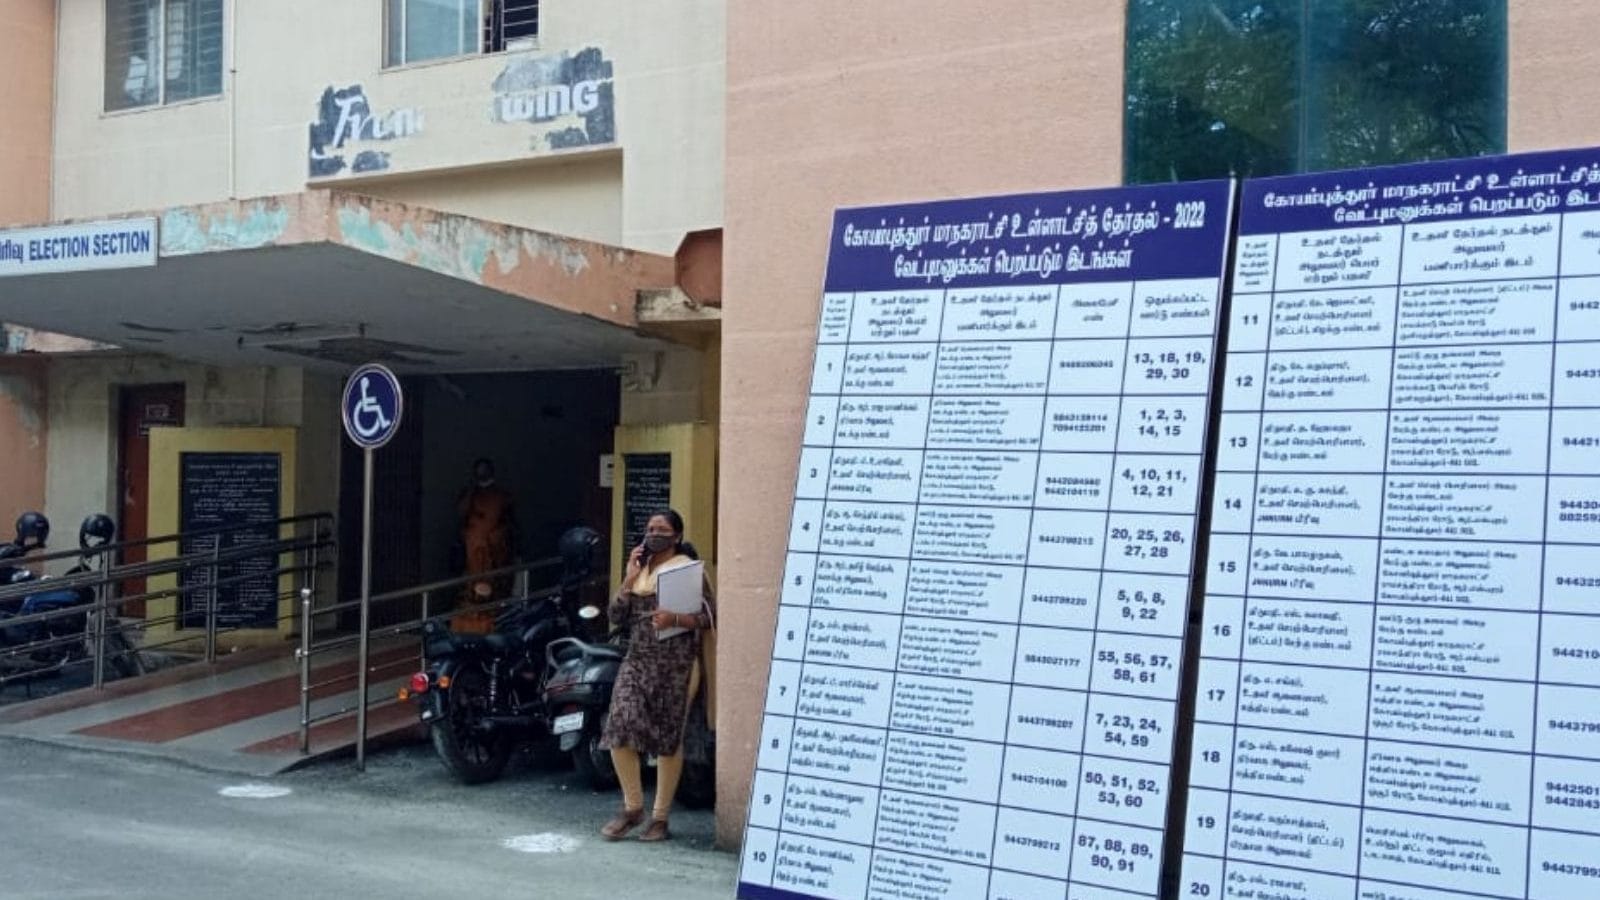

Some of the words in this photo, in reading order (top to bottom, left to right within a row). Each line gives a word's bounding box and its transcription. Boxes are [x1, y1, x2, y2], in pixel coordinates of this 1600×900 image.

[1264, 182, 1377, 210] கோயம்புத்தூர்
[1383, 175, 1481, 201] மாநகராட்சி
[1333, 196, 1464, 225] வேட்புமனுக்கள்
[1468, 188, 1561, 215] பெறப்படும்
[1566, 189, 1600, 206] இட
[843, 216, 930, 252] கோயம்புத்தூர்
[933, 212, 1008, 249] மாநகராட்சி
[1011, 205, 1097, 239] உள்ளாட்சித்
[1102, 201, 1159, 237] தேர்தல்
[1174, 201, 1205, 228] 2022
[29, 236, 89, 261] ELECTION
[93, 230, 149, 256] SECTION
[995, 243, 1063, 278] பெறப்படும்
[1066, 237, 1133, 271] இடங்கள்
[1243, 314, 1258, 325] 11
[1134, 353, 1154, 365] 13,
[1160, 353, 1179, 364] 18,
[1185, 351, 1206, 364] 19,
[828, 362, 832, 371] 1
[1146, 368, 1167, 380] 29,
[1172, 368, 1189, 379] 30
[1236, 375, 1253, 387] 12
[817, 415, 825, 425] 2
[1140, 409, 1152, 421] 1,
[1156, 409, 1169, 422] 2,
[1174, 409, 1186, 421] 3,
[1139, 425, 1158, 437] 14,
[1165, 426, 1181, 436] 15
[1229, 437, 1247, 447] 13
[810, 468, 817, 478] 3
[1122, 468, 1134, 481] 4,
[1141, 469, 1160, 481] 10,
[1166, 470, 1186, 483] 11,
[1132, 485, 1152, 498] 12,
[1157, 486, 1172, 497] 21
[1225, 499, 1241, 509] 14
[802, 522, 810, 531] 4
[1111, 528, 1132, 541] 20,
[1136, 529, 1158, 543] 25,
[1163, 530, 1184, 544] 26,
[1124, 545, 1146, 559] 27,
[1150, 546, 1168, 558] 28
[1219, 561, 1236, 573] 15
[795, 576, 802, 586] 5
[1117, 590, 1130, 603] 5,
[1135, 591, 1147, 604] 6,
[1152, 592, 1165, 605] 8,
[1122, 606, 1134, 620] 9,
[1139, 608, 1157, 620] 22
[787, 631, 794, 641] 6
[1213, 625, 1230, 636] 16
[1098, 651, 1118, 664] 55,
[1124, 653, 1145, 667] 56,
[1150, 655, 1172, 669] 57,
[1114, 668, 1134, 683] 58,
[1140, 671, 1156, 683] 61
[780, 686, 786, 696] 7
[1208, 689, 1225, 701] 17
[1096, 713, 1108, 727] 7,
[1112, 715, 1134, 730] 23,
[1139, 718, 1161, 733] 24,
[772, 739, 779, 749] 8
[1104, 731, 1126, 747] 54,
[1131, 734, 1149, 747] 59
[1202, 751, 1220, 763] 18
[1085, 772, 1106, 787] 50,
[1111, 775, 1132, 790] 51,
[1138, 779, 1159, 794] 52,
[764, 794, 771, 804] 9
[1098, 791, 1120, 807] 53,
[1124, 795, 1142, 807] 60
[1197, 816, 1215, 828] 19
[1078, 834, 1099, 850] 87,
[1104, 839, 1126, 855] 88,
[1131, 843, 1153, 859] 89,
[753, 851, 767, 862] 10
[1091, 854, 1113, 871] 90,
[1118, 859, 1134, 872] 91
[1190, 882, 1210, 897] 20
